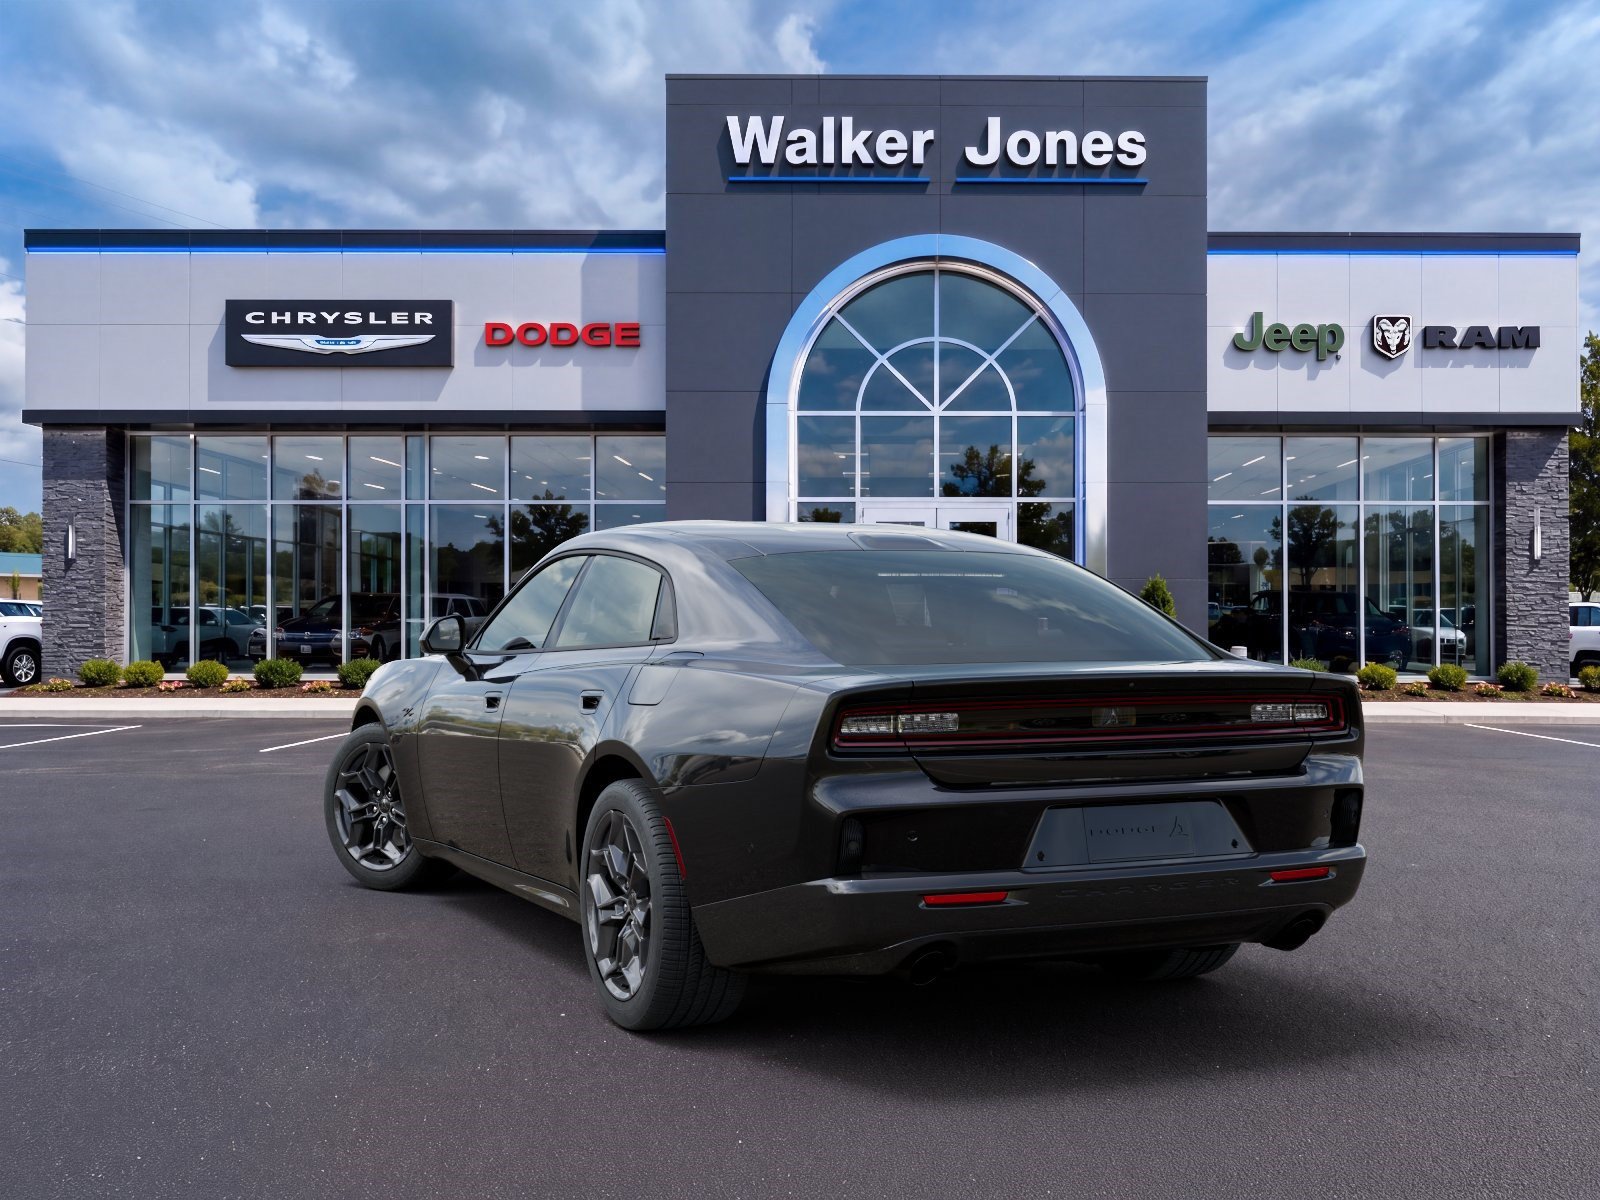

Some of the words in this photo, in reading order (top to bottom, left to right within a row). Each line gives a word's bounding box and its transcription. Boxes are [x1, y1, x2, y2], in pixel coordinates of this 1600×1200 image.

[726, 115, 935, 164] Walker
[964, 116, 1148, 166] Jones
[245, 311, 434, 325] CHRYSLER
[484, 322, 641, 347] DODGE
[1233, 311, 1345, 360] Jeep
[1422, 325, 1541, 348] RAM
